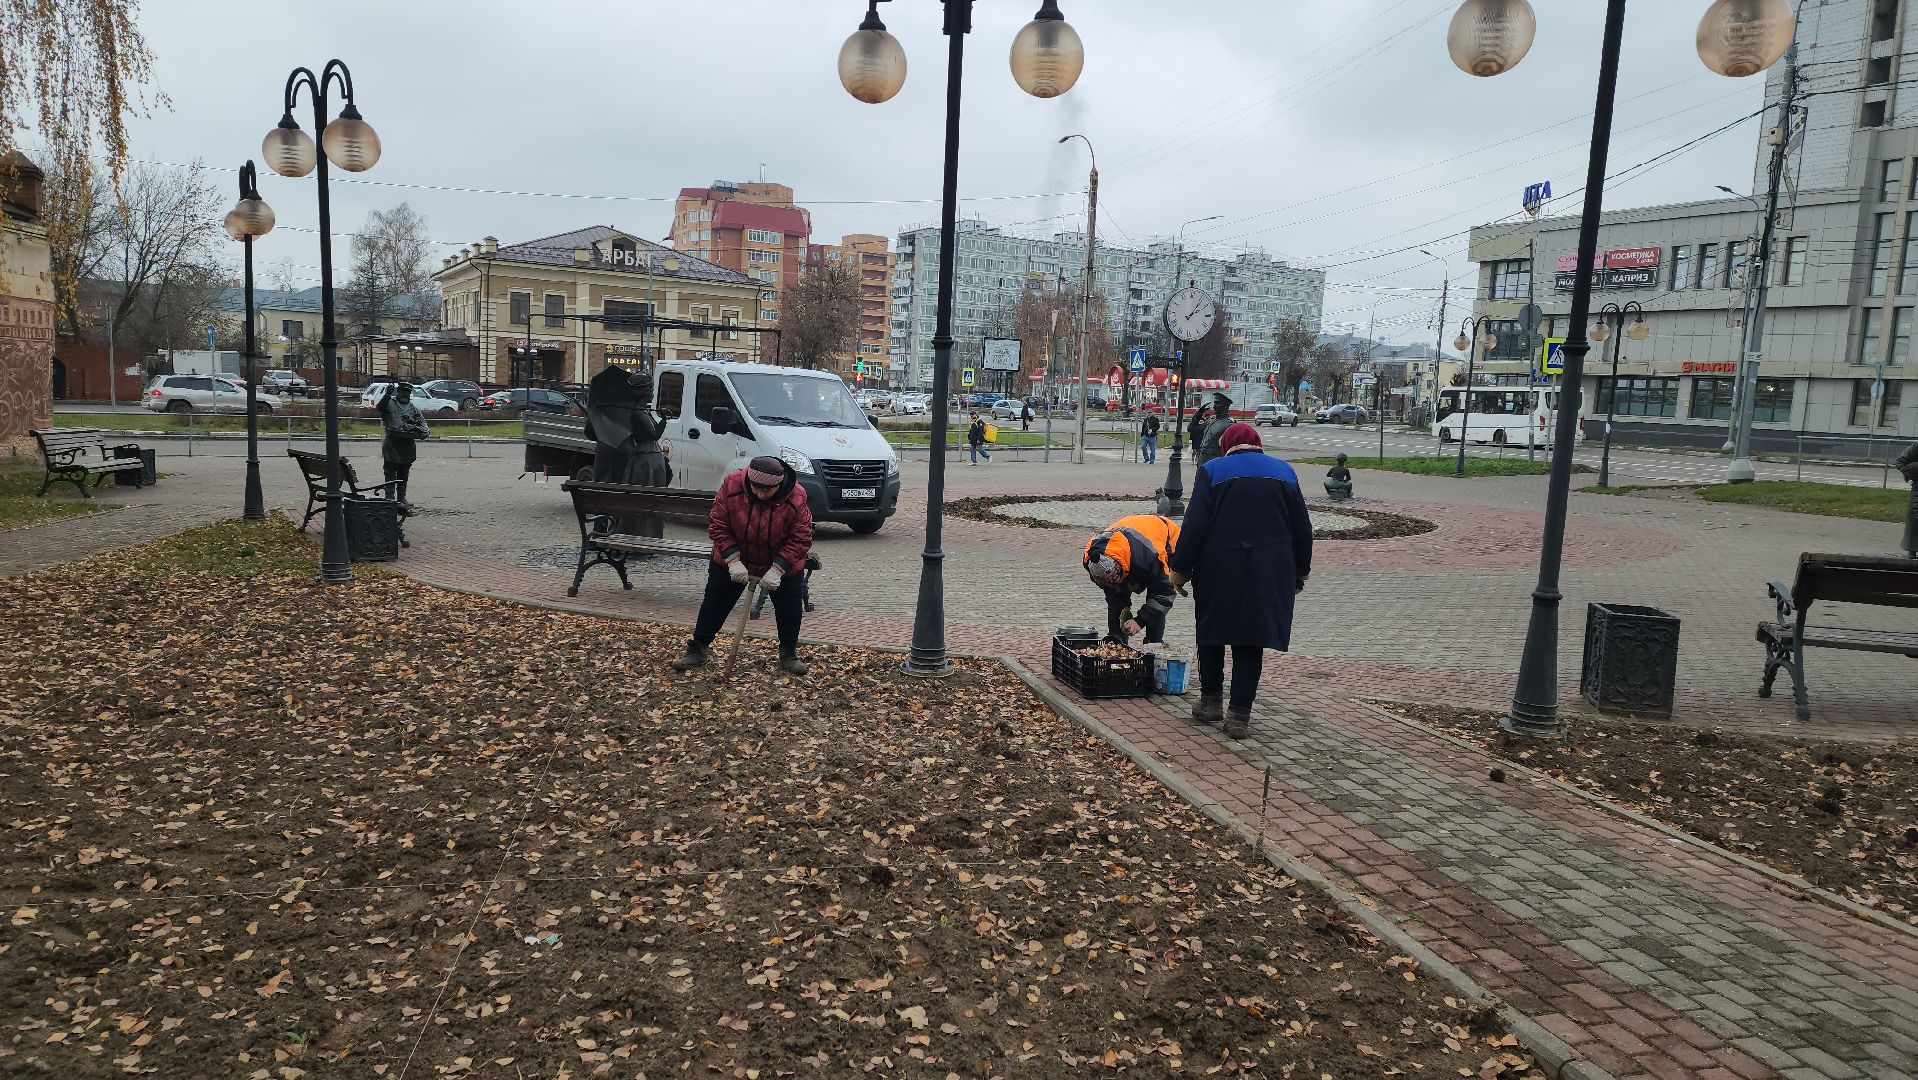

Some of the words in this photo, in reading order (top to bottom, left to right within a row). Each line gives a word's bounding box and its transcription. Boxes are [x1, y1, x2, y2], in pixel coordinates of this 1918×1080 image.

[602, 248, 652, 268] АРБАТ
[1611, 251, 1655, 260] КОСМЕТИКА
[1558, 274, 1597, 287] МОДЙ
[1611, 273, 1649, 283] КАПРИЗ
[1695, 362, 1738, 373] МАГНИ
